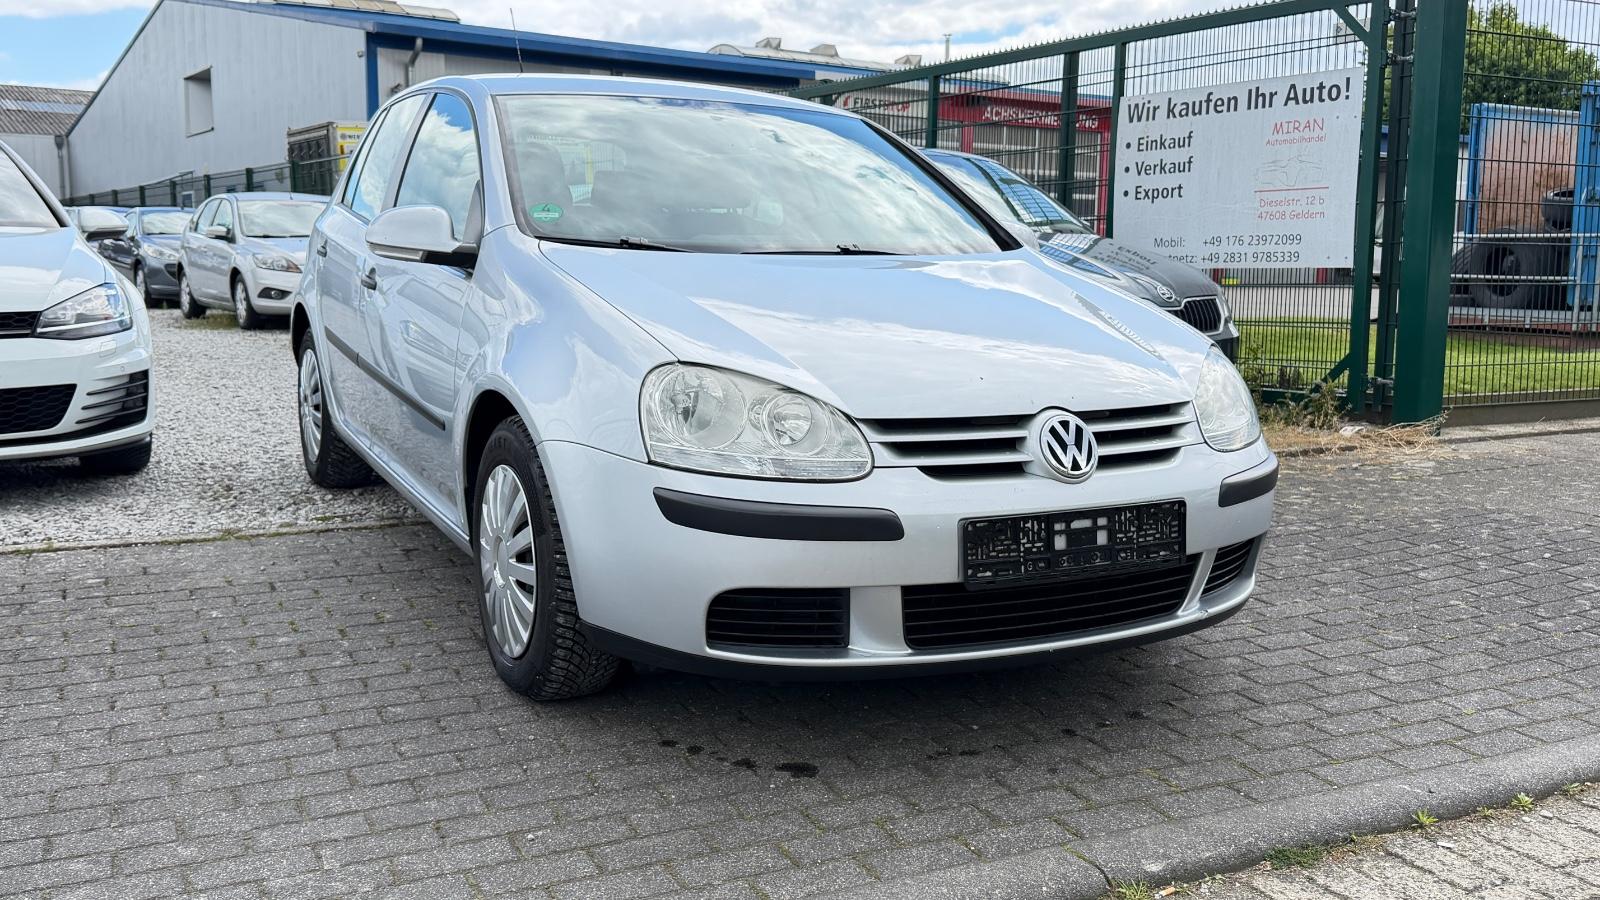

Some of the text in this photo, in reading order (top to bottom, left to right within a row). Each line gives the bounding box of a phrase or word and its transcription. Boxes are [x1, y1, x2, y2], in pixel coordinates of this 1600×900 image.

[1127, 77, 1351, 123] Wir kaufen Ihr Auto!
[1272, 117, 1325, 136] MIRAN
[1137, 130, 1194, 152] Einkauf
[1265, 133, 1327, 147] Automobilhandel
[1135, 155, 1194, 177] Verkauf
[1134, 183, 1184, 204] Export
[1259, 195, 1325, 208] Dieselstr. 12 b
[1257, 209, 1325, 221] 47608 Geldern
[1153, 234, 1302, 249] Mobil: +49 176 23972099
[1200, 252, 1220, 264] +49
[1222, 252, 1248, 264] 2831
[1252, 251, 1300, 263] 9785339
